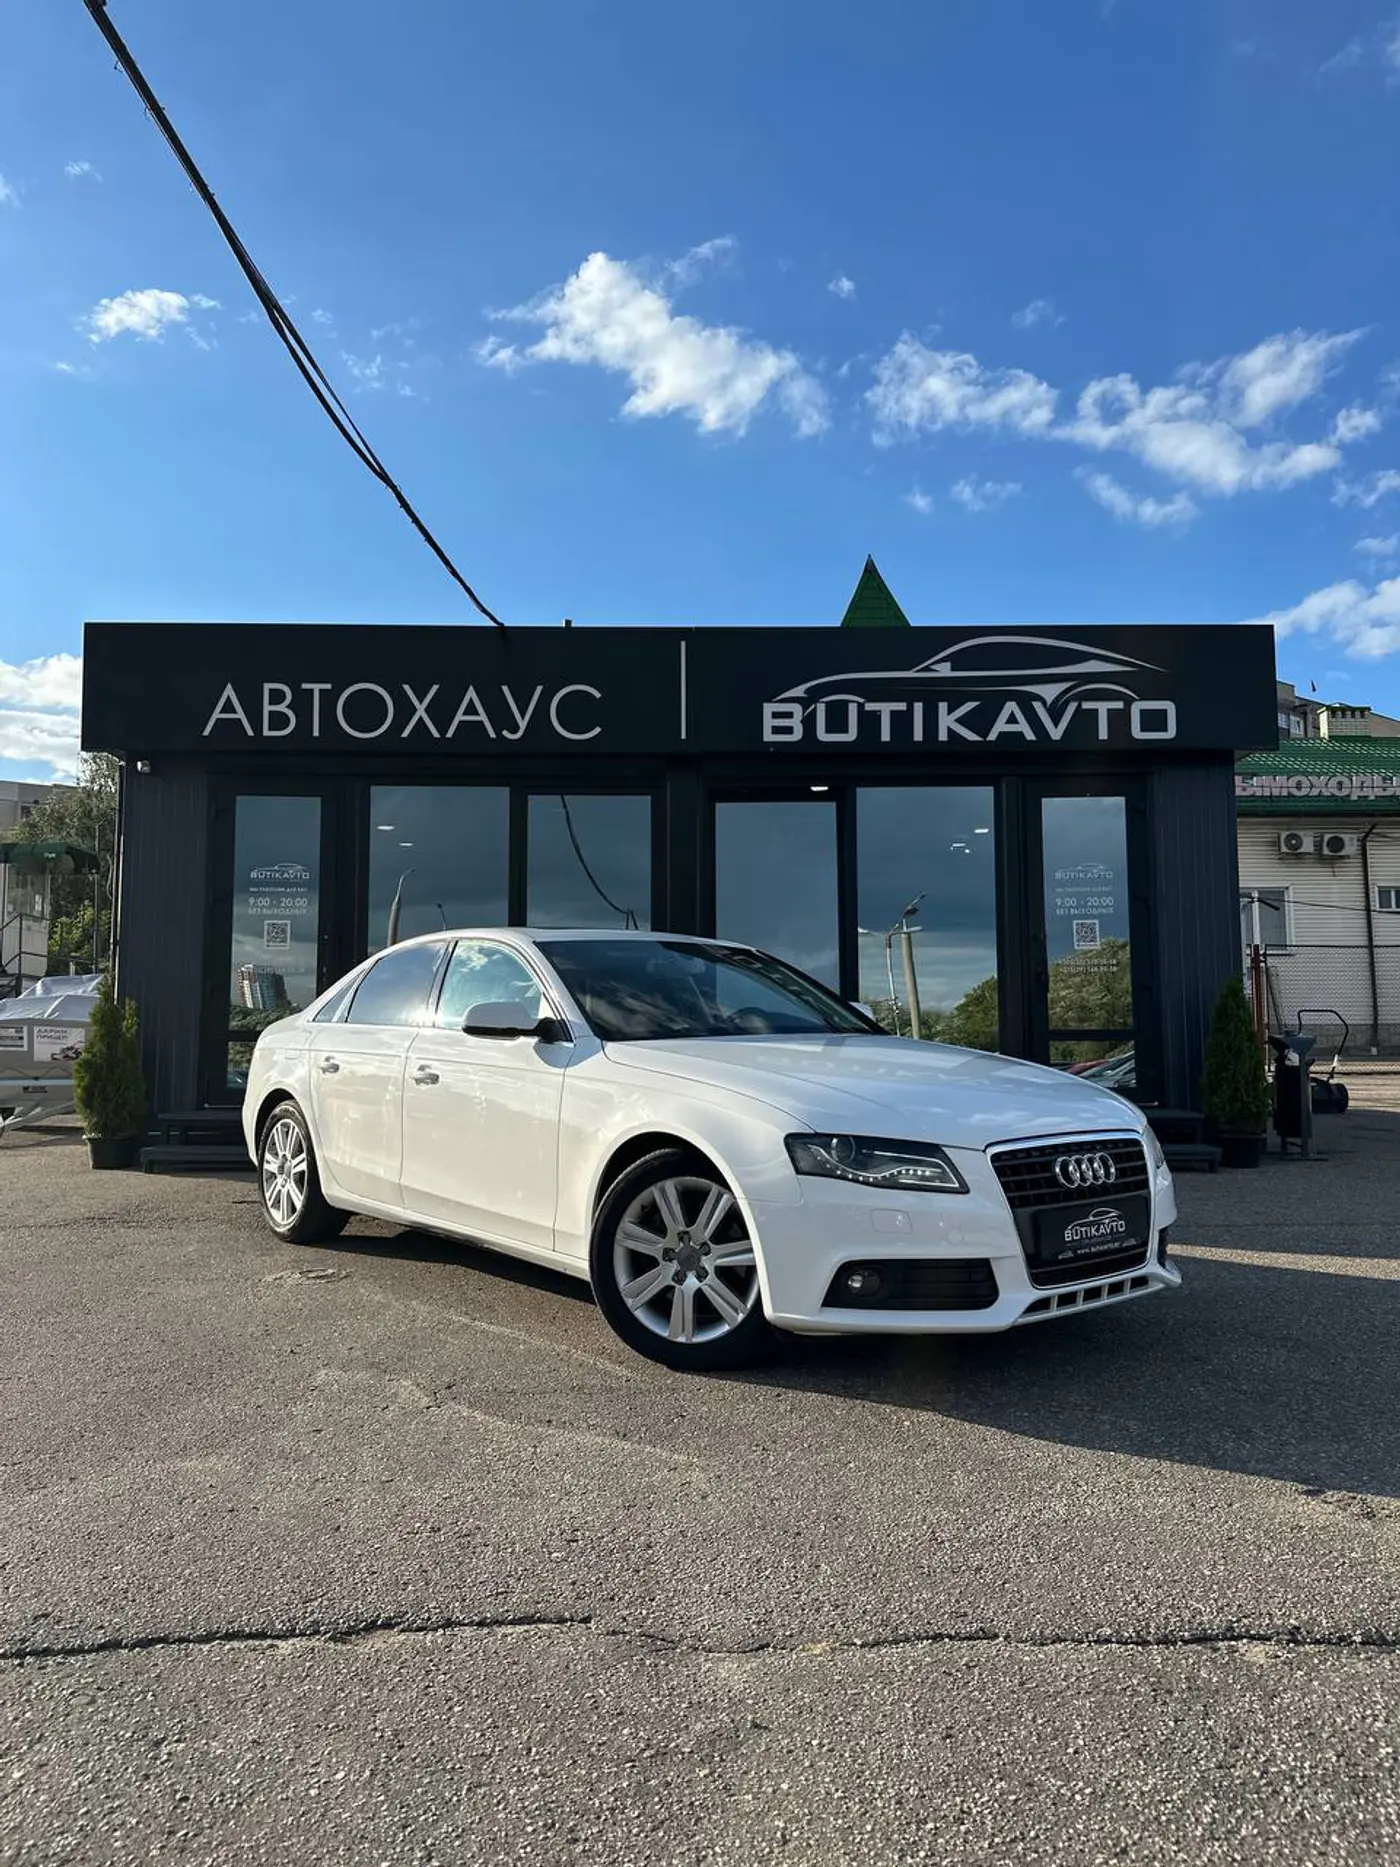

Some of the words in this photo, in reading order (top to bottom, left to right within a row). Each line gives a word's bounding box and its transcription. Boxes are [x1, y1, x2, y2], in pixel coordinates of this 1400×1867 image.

[202, 682, 602, 740] АВТОХАУС
[762, 699, 1177, 742] BUTIKAVTO
[248, 896, 270, 907] 9:00
[1064, 1220, 1126, 1241] BUTIKAVTO
